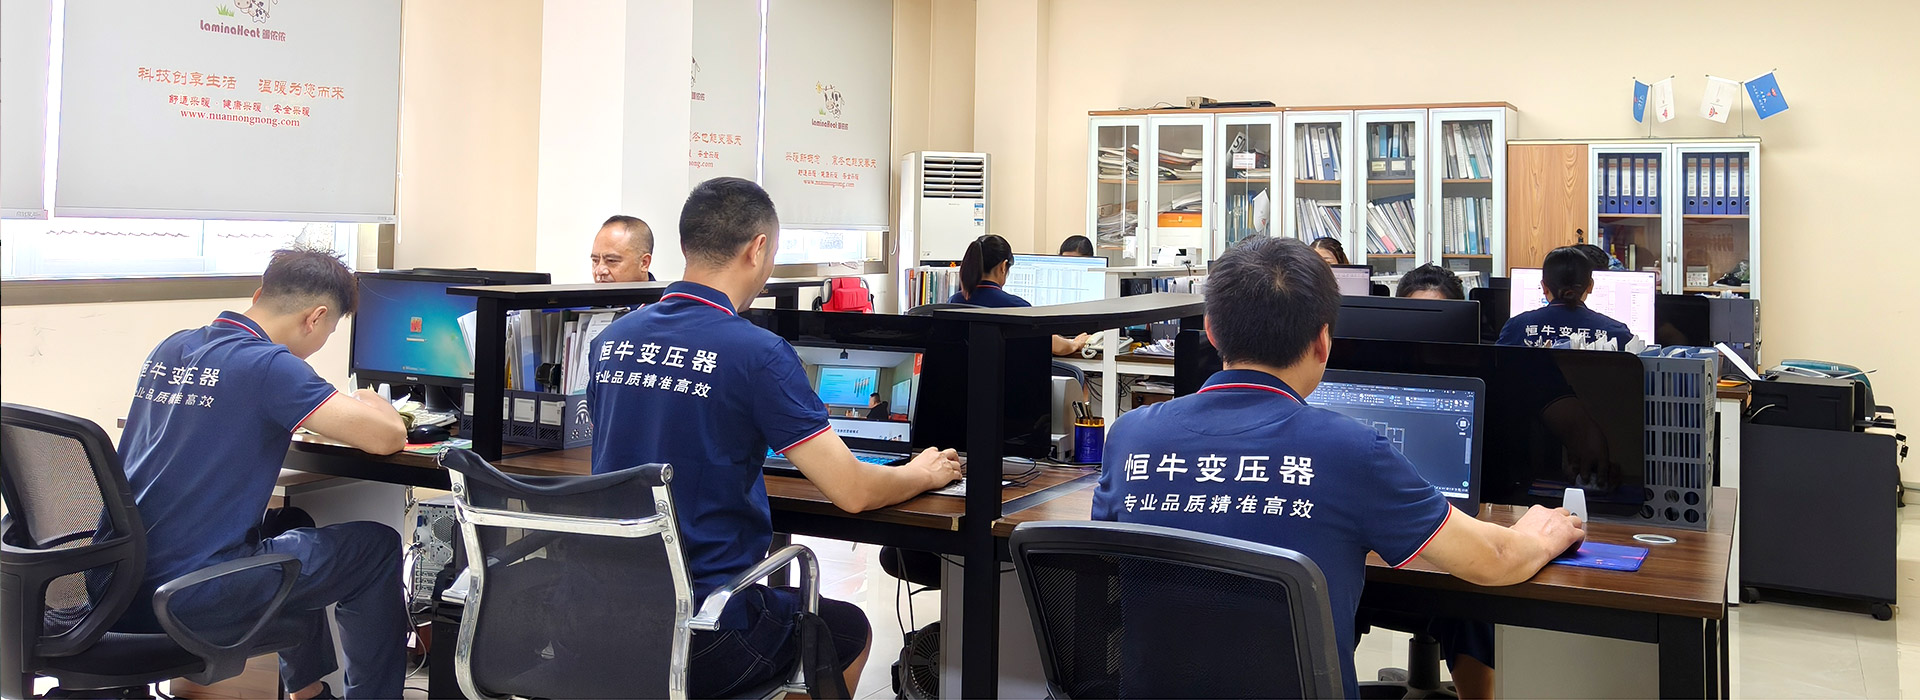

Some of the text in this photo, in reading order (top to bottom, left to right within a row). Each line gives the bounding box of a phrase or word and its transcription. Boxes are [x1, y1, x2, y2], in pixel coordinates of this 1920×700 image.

[200, 19, 260, 39] LaminaHeat
[137, 67, 345, 100] 科技创享生活 温暖为您而来
[180, 109, 301, 128] www.nuannongnong.com
[134, 386, 215, 408] 业品质精准高效
[1124, 453, 1315, 486] 恒牛变压器
[1123, 493, 1315, 519] 专业品质精准高效
